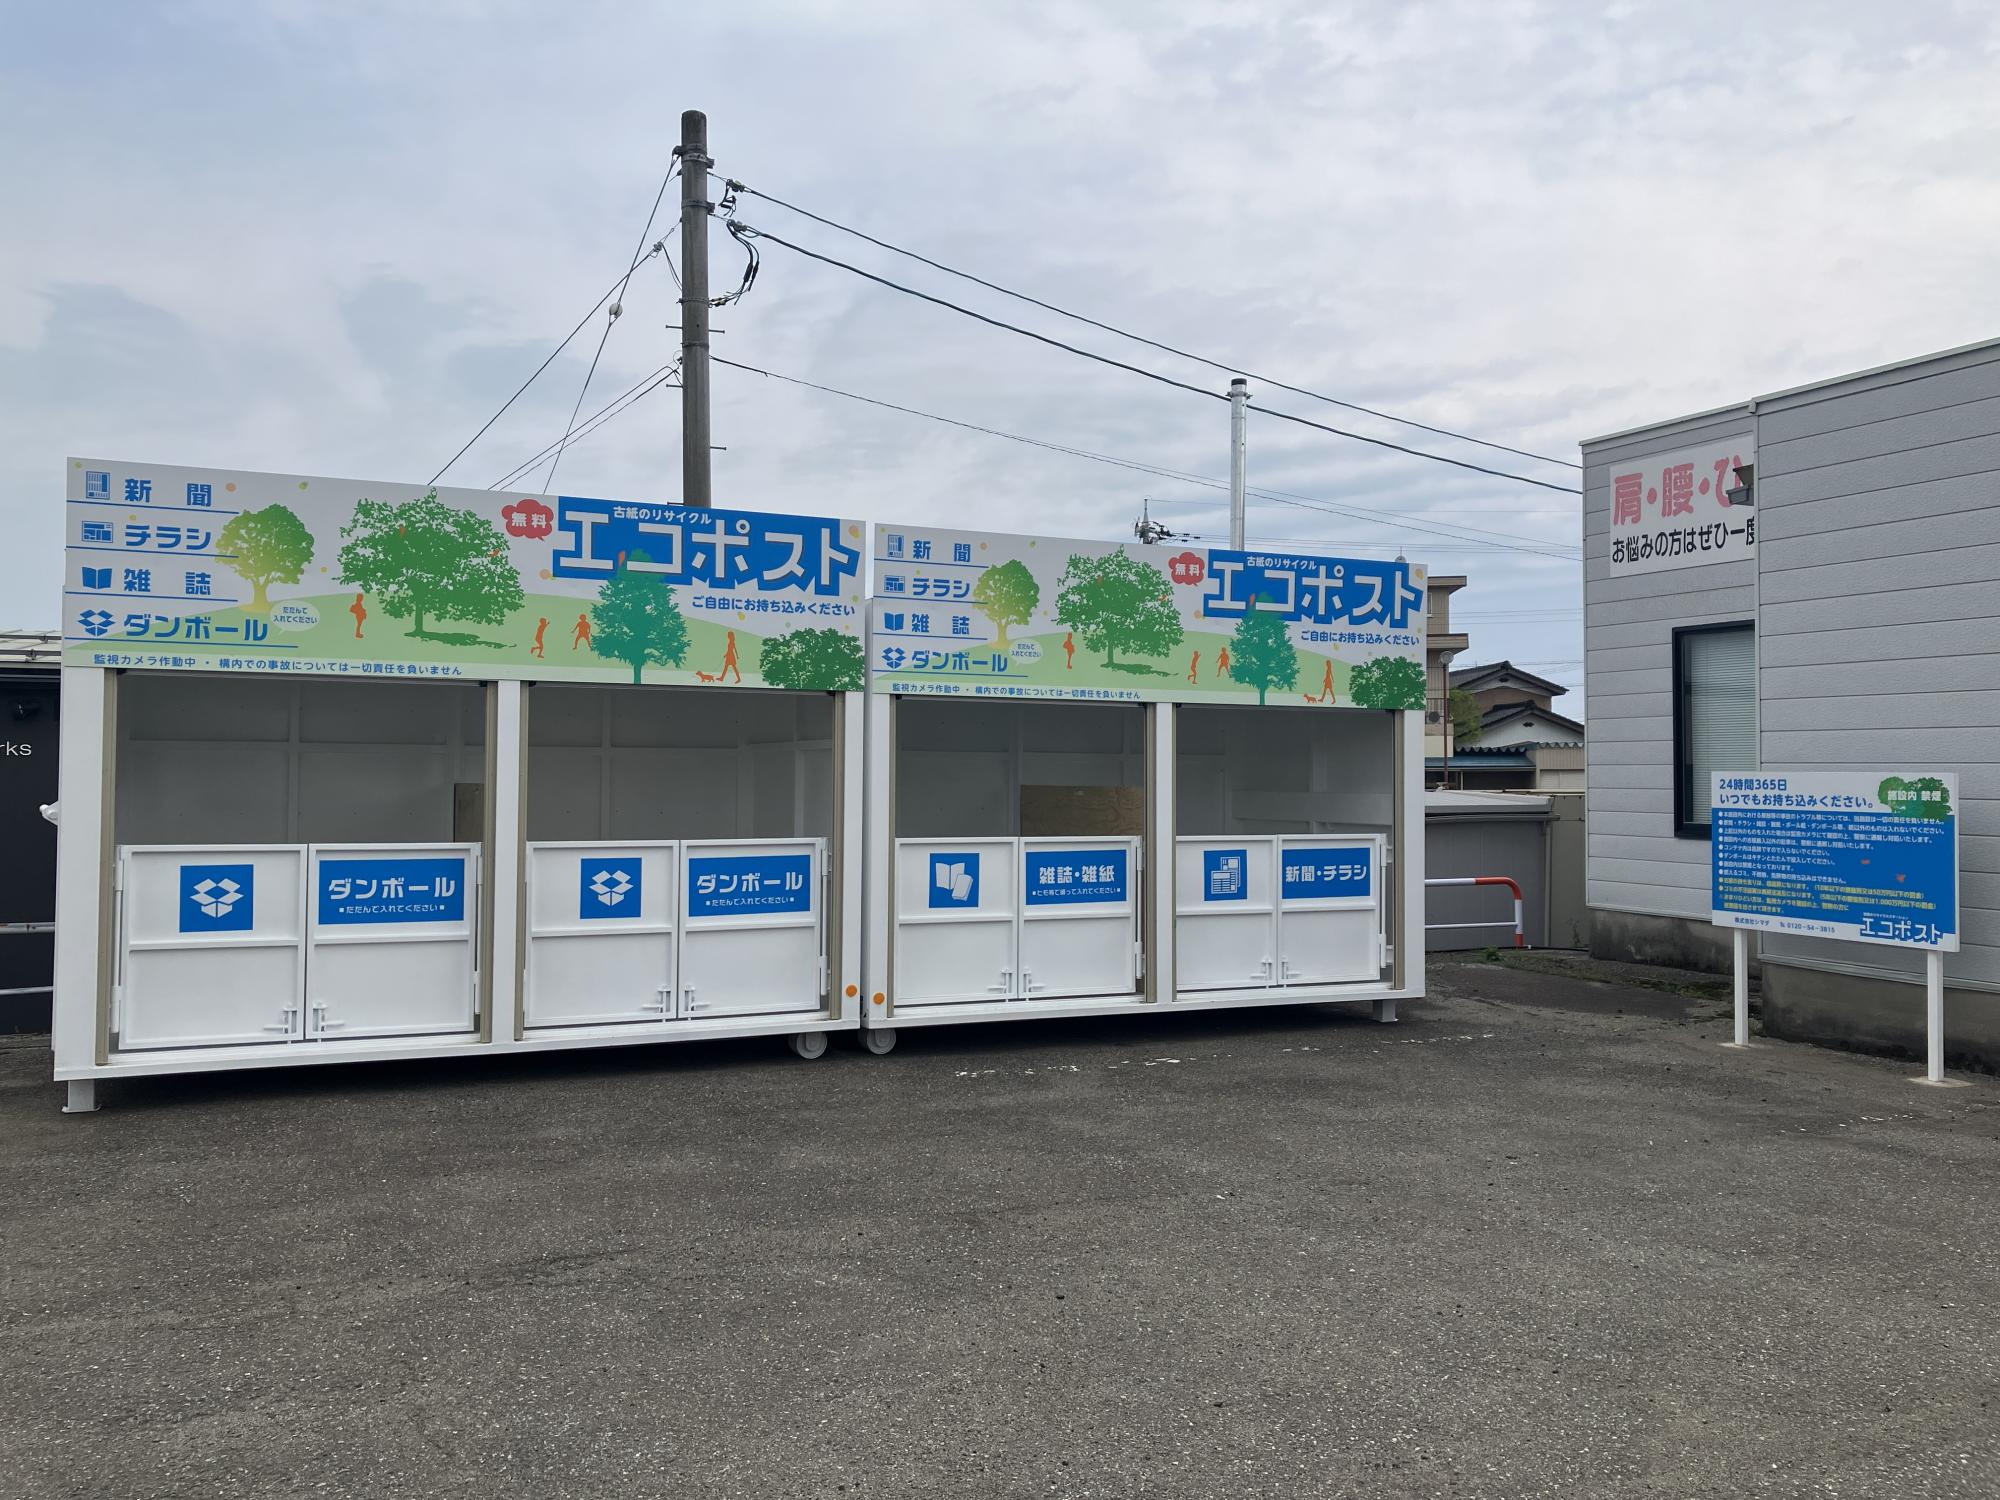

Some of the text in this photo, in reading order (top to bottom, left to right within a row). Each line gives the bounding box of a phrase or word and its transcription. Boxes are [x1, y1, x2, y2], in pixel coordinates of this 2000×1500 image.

[125, 478, 212, 507] 新聞
[511, 511, 547, 530] 無料
[613, 505, 712, 526] 古紙のリサイクル
[125, 524, 212, 551] チラシ
[560, 510, 850, 586] エコポスト
[912, 540, 971, 563] 新聞
[1174, 563, 1200, 577] 無料
[1246, 556, 1318, 571] 古紙のリサイクル
[124, 568, 212, 596] 雑誌
[912, 577, 971, 599] チラシ
[1208, 561, 1416, 620] エコポスト
[692, 595, 856, 617] ご自由にお持ち込みください
[124, 613, 269, 642] ダンボール
[911, 613, 970, 636] 雑誌
[1301, 630, 1420, 646] ご自由にお持ち込みください
[911, 650, 1008, 673] ダンボール
[1719, 778, 1788, 791] 24時間365日
[1719, 793, 1874, 809] いつでもお持ち込みください。
[697, 871, 803, 894] ダンボール
[1039, 865, 1115, 884] 雑誌・雑紙
[1286, 864, 1367, 883] 新聞・チラシ
[329, 876, 456, 900] ダンボール
[1861, 917, 1941, 942] エコポスト
